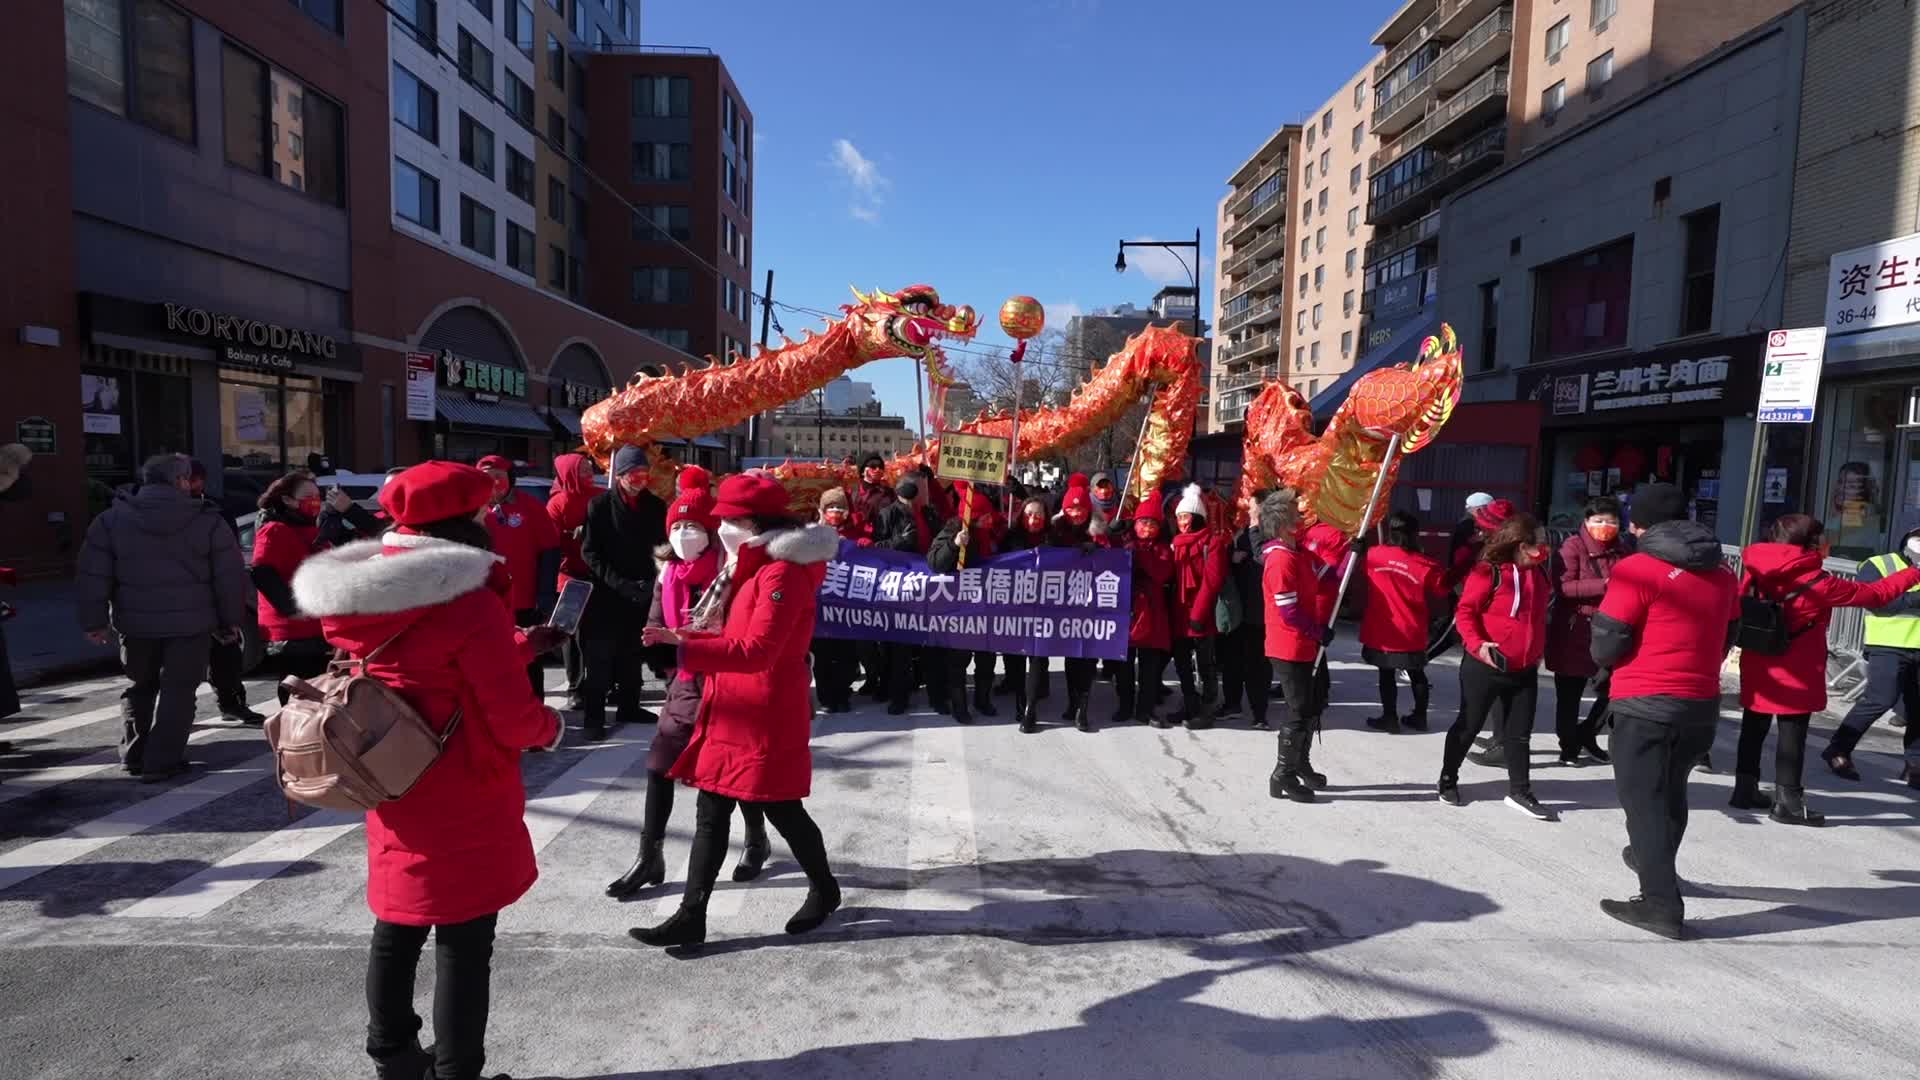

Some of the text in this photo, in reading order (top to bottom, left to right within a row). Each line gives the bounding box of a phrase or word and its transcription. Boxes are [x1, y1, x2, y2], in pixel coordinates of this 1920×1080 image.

[1836, 305, 1877, 325] 36-44
[164, 302, 337, 359] KORYODANG
[227, 347, 259, 366] Bakery
[262, 354, 269, 364] &
[1769, 362, 1779, 376] 2
[821, 560, 1120, 609] 美國紐約大馬僑胞同鄉會
[822, 604, 1117, 640] NY(USA) MALAYSIAN UNITED GROUP
